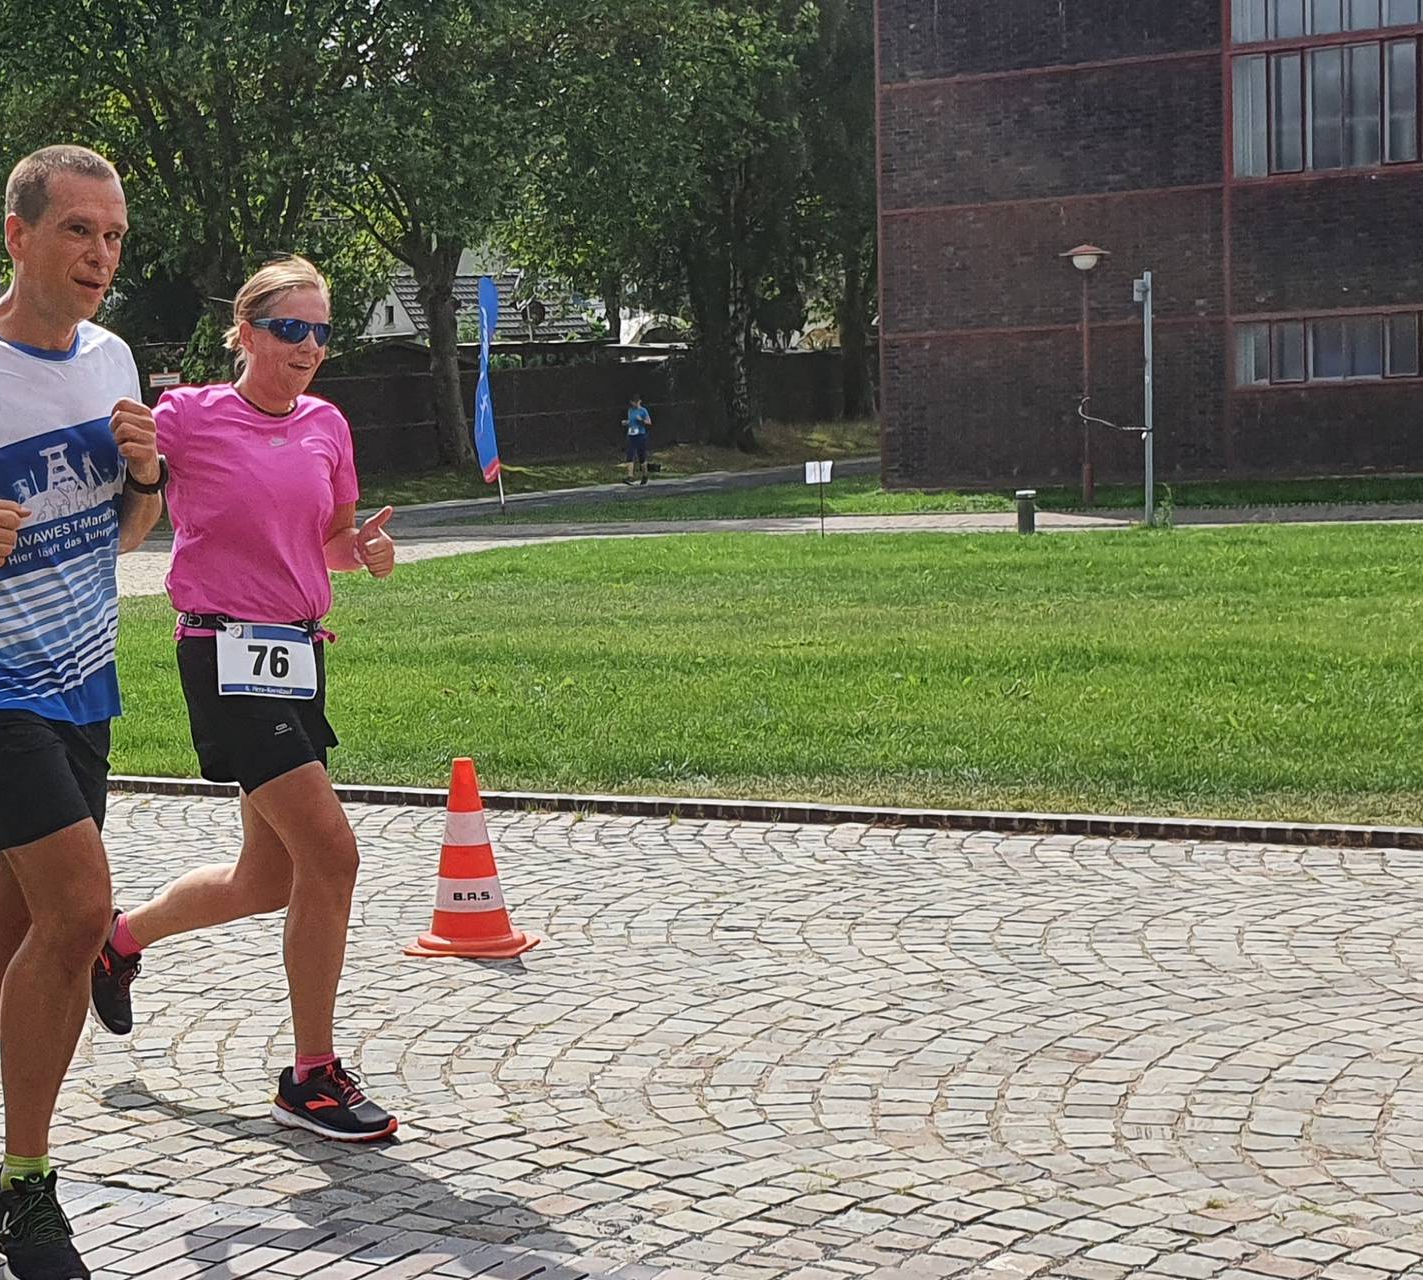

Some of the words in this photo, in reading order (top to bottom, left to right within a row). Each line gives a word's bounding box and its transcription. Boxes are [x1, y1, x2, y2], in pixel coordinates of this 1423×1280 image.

[8, 551, 33, 566] Hier
[64, 537, 82, 550] das
[247, 644, 290, 678] 76
[453, 891, 494, 901] B.A.S.
